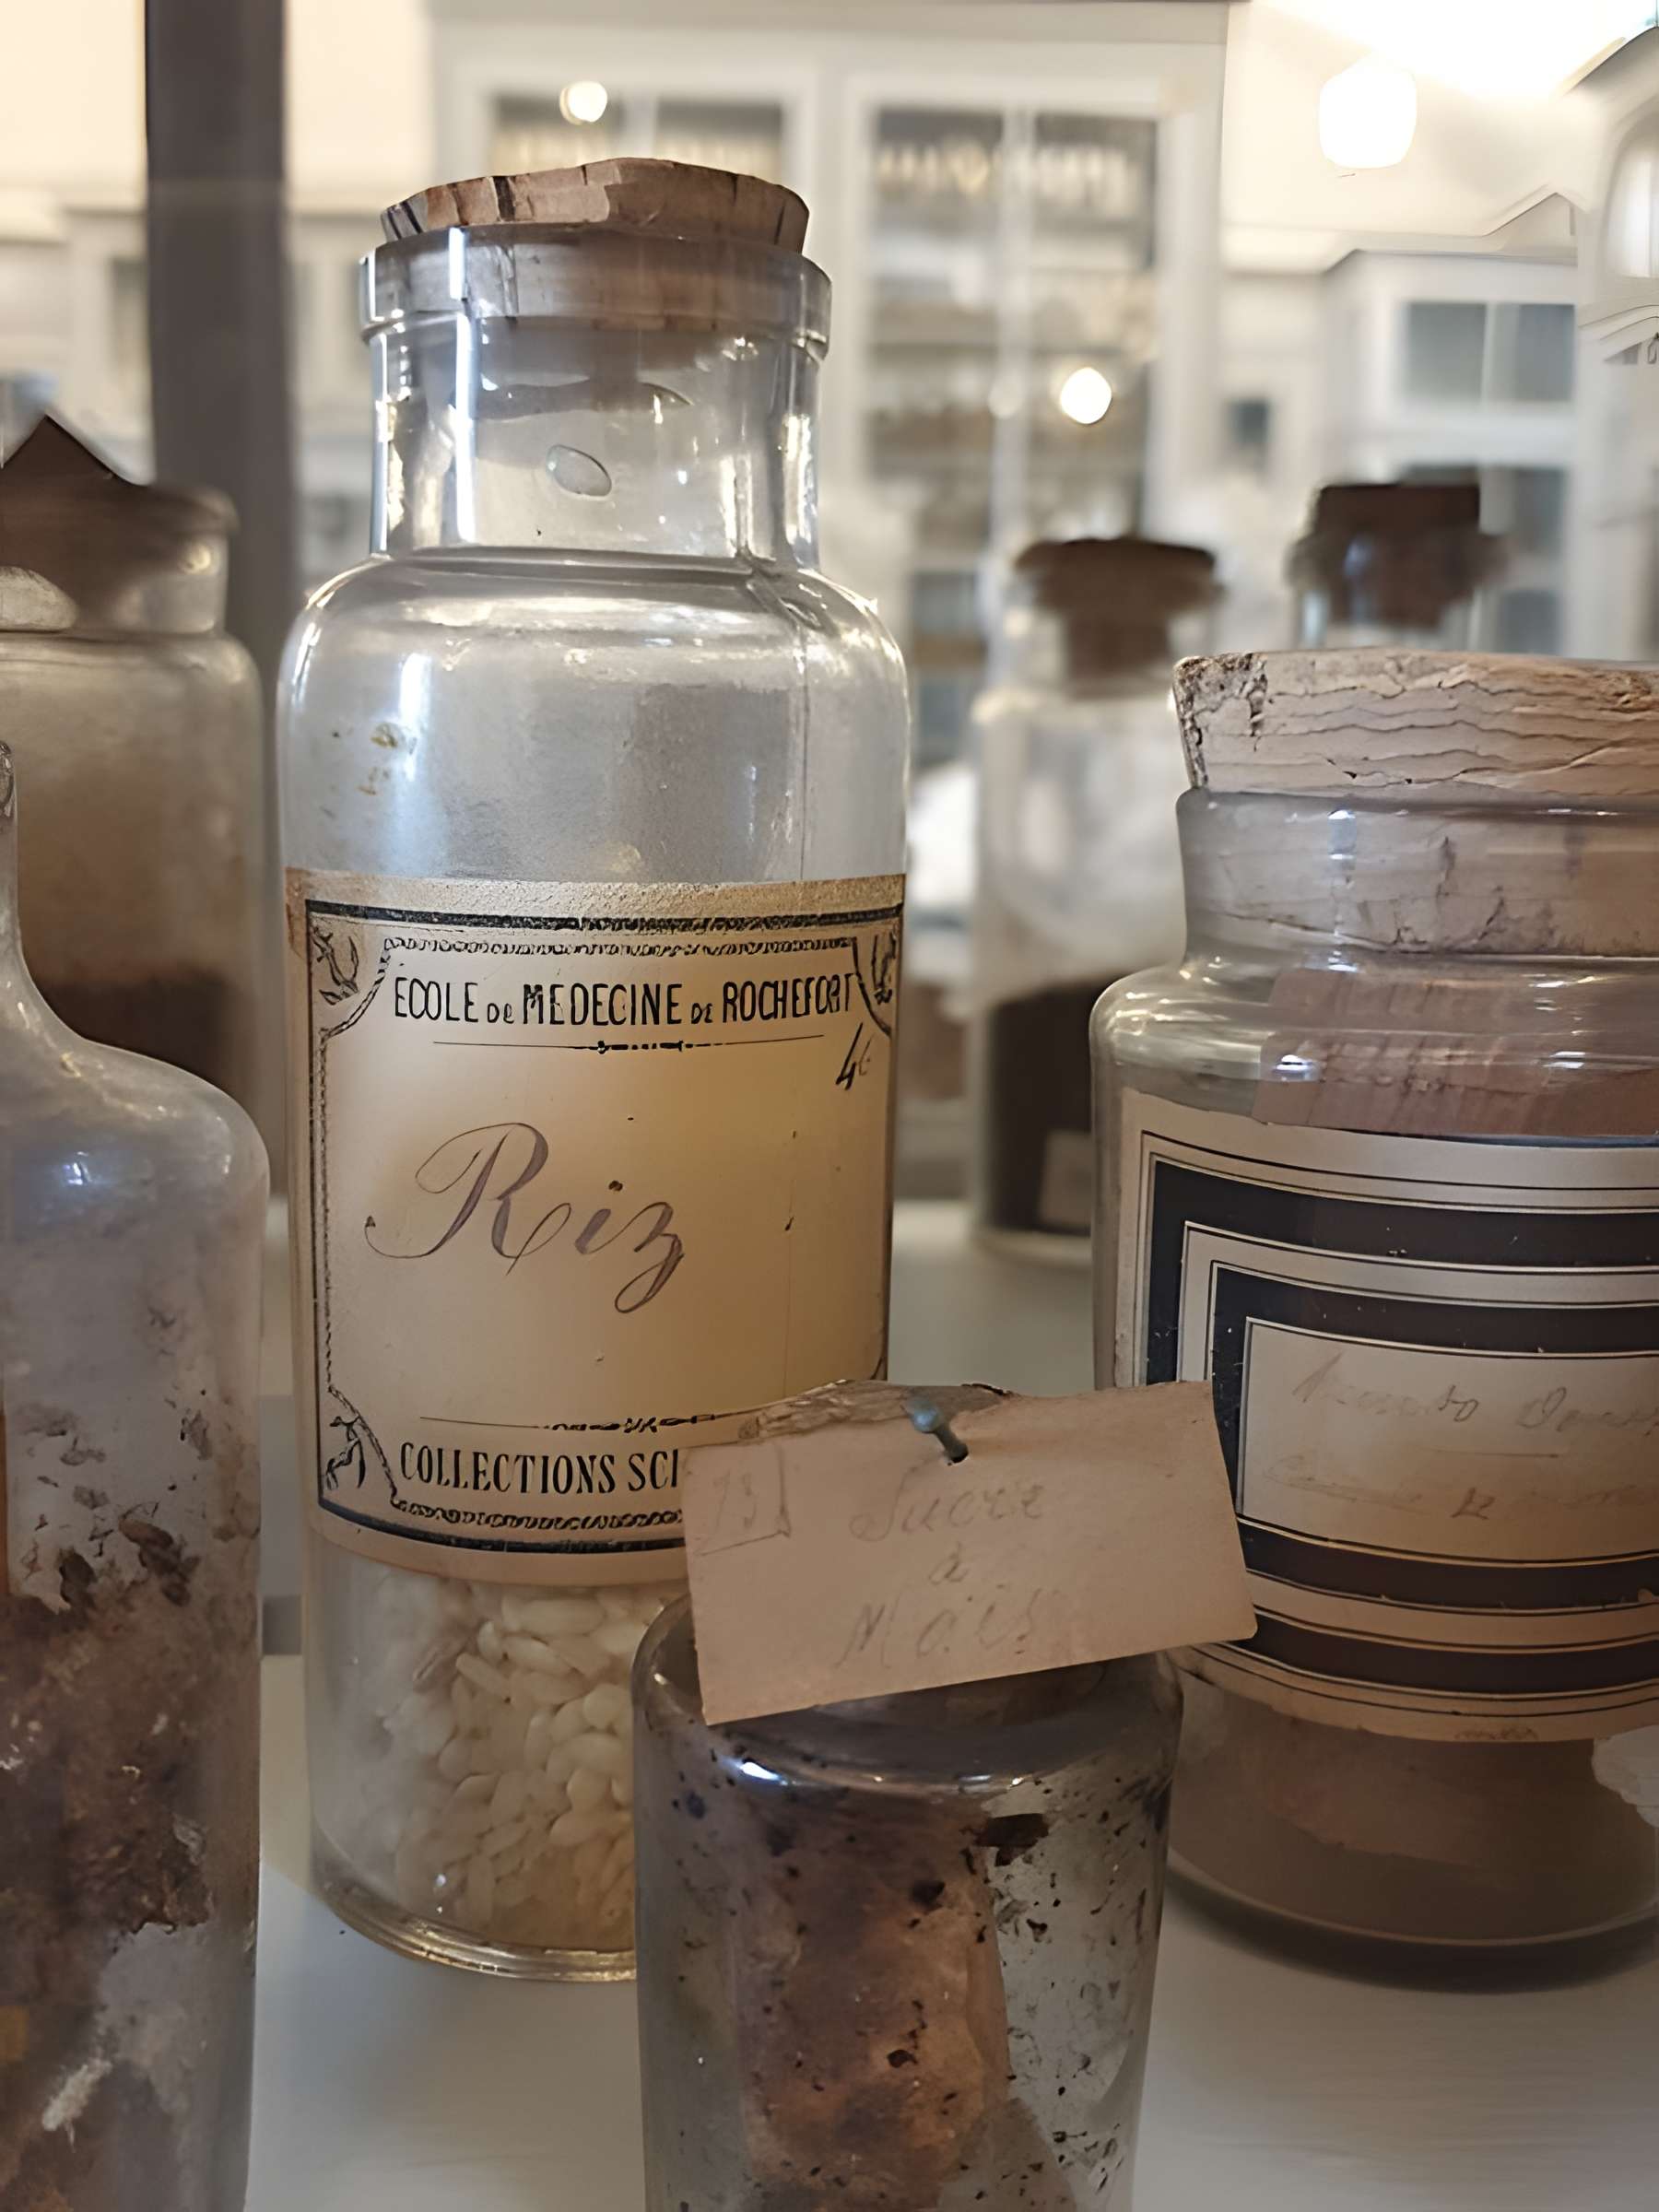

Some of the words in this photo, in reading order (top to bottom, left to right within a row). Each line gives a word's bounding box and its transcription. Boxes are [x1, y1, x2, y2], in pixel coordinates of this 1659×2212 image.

[364, 1122, 684, 1313] Riz
[400, 1441, 617, 1495] COLLECTIONS
[628, 1449, 678, 1492] SCI
